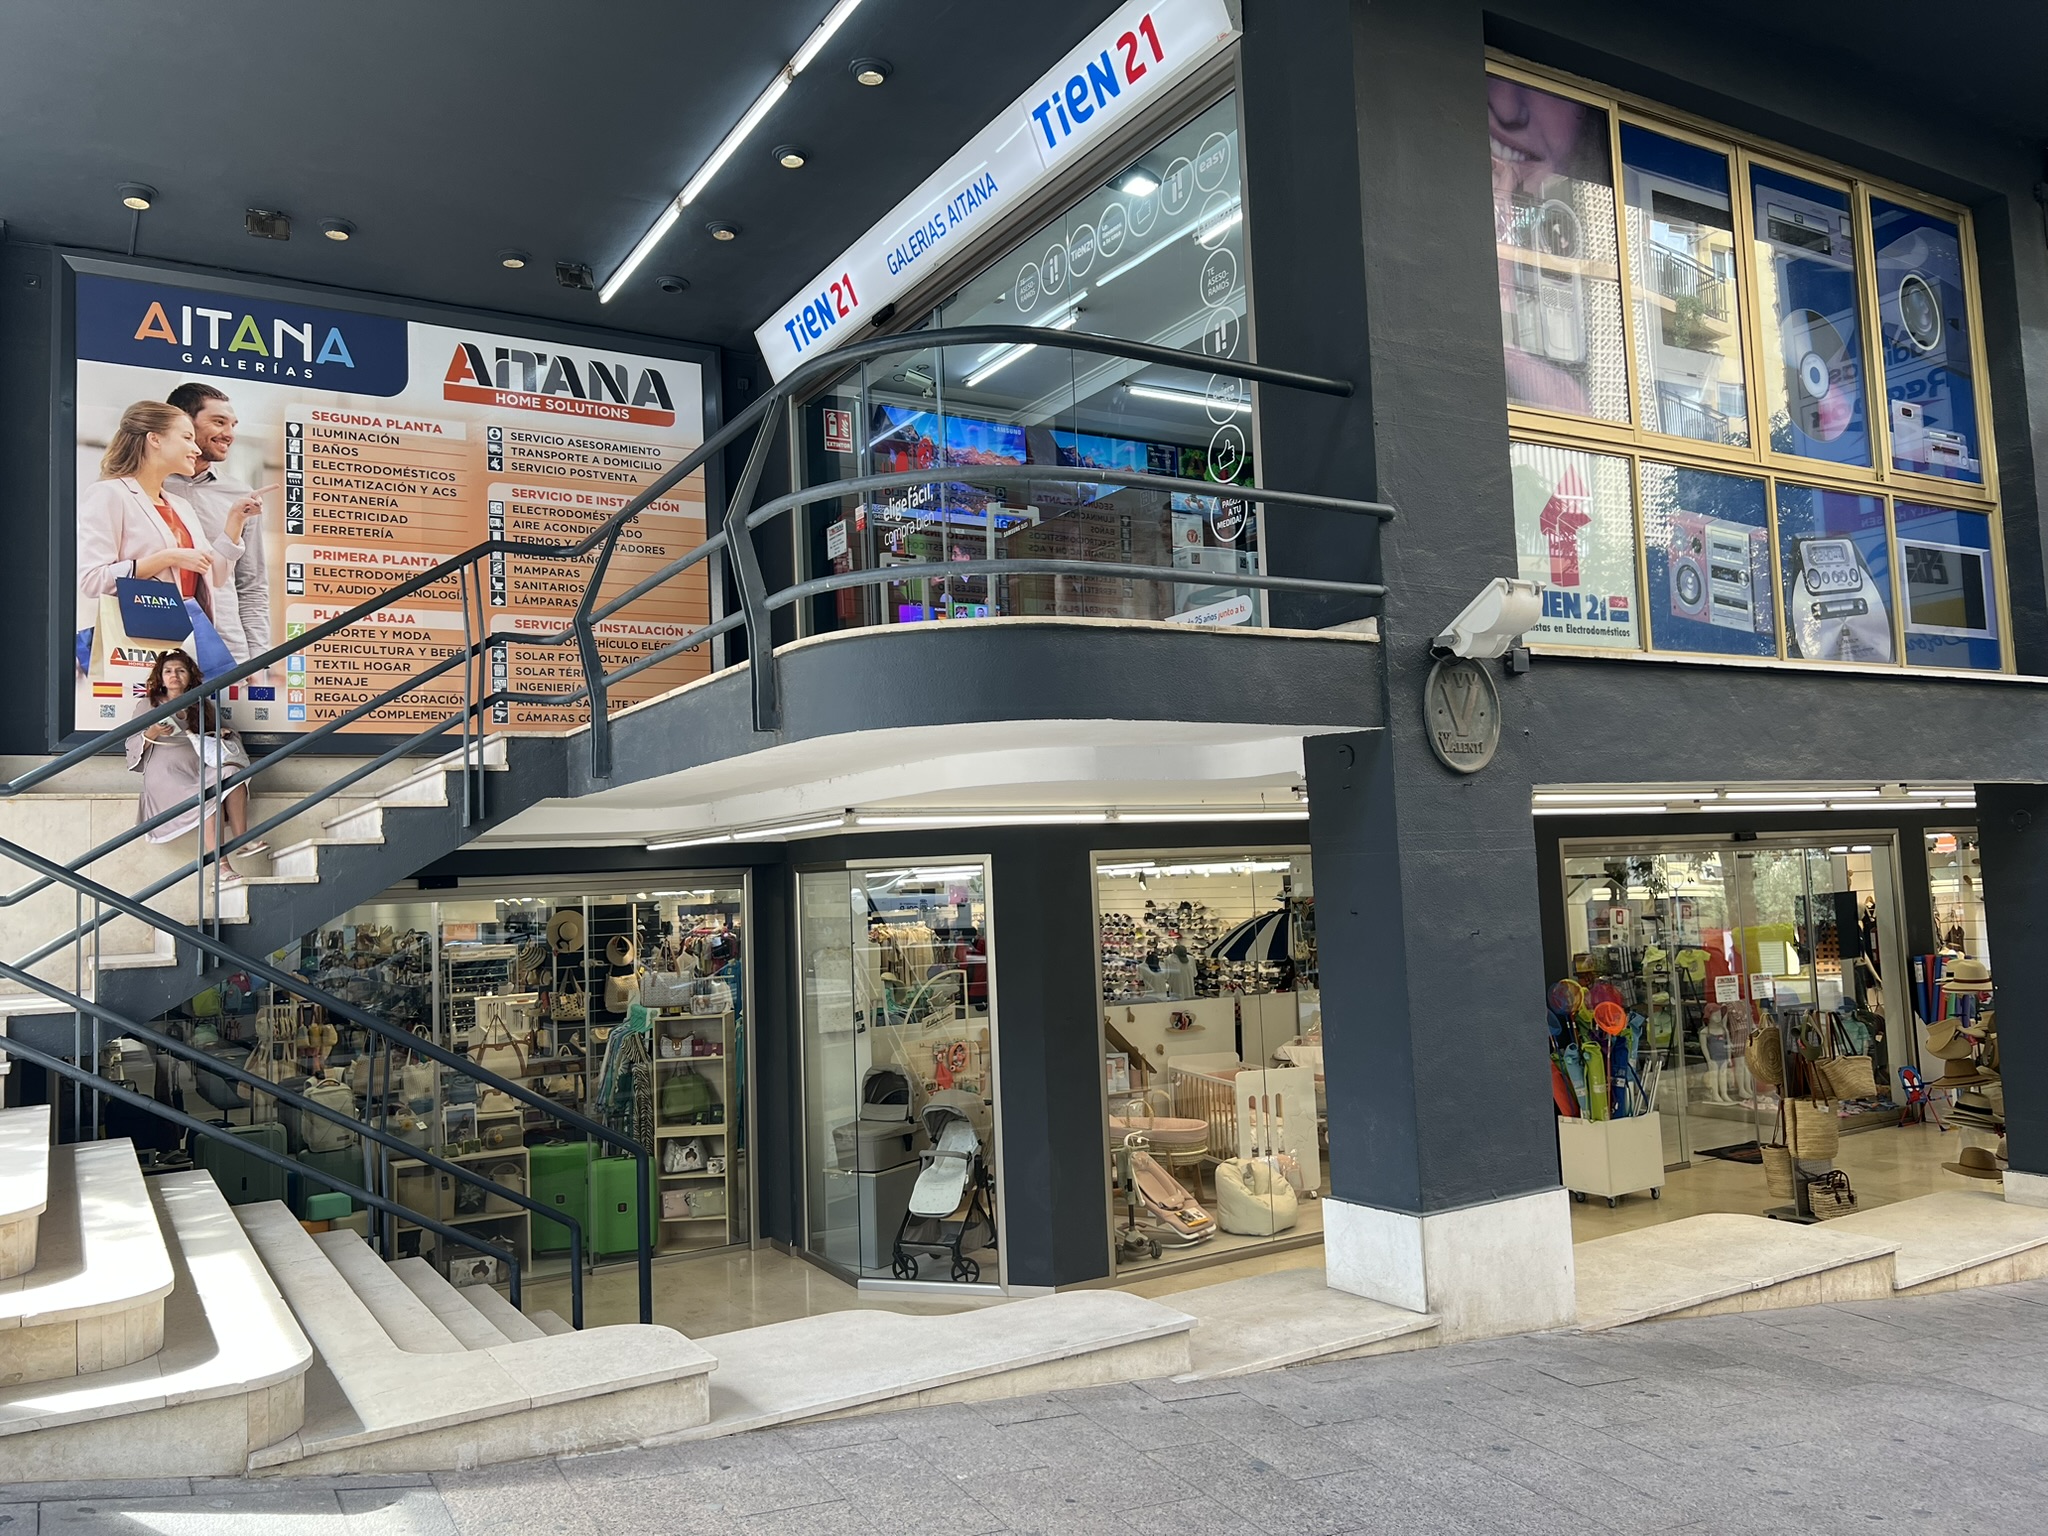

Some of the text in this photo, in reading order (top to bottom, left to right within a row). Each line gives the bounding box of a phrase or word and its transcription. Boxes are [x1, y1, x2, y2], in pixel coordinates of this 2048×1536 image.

[1200, 148, 1226, 173] easy
[886, 172, 999, 277] GALERIAS AITANA
[1207, 267, 1215, 277] TE
[1207, 270, 1230, 287] ASESO-
[1208, 279, 1230, 297] RAMOS
[134, 301, 355, 369] AITANA
[182, 352, 314, 379] GALERÍAS
[444, 341, 675, 411] AITANA
[496, 393, 630, 420] HOME SOLUTIONS
[312, 411, 443, 434] SEGUNDA PLANTA
[312, 428, 400, 445] ILUMINACIÓN
[510, 431, 661, 457] SERVICIO ASESORAMIENTO
[312, 443, 359, 457] BAÑOS
[511, 447, 662, 471] TRANSPORTE A DOMICILIO
[312, 460, 456, 481] ELECTRODOMÉSTICOS
[511, 462, 637, 483] SERVICIO POSTVENTA
[312, 476, 457, 497] CLIMATIZACIÓN Y ACS
[312, 492, 398, 507] FONTANERÍA
[512, 488, 680, 513] SERVICIO DE INSTACIÓN
[313, 509, 408, 524] ELECTRICIDAD
[512, 505, 639, 524] ELECTRODOMÉSTOS
[1217, 514, 1242, 530] MEDIDA!
[313, 524, 393, 538] FERRETERÍA
[512, 520, 642, 539] AIRE ACONDICADO
[884, 521, 915, 546] compra
[916, 511, 935, 533] bien
[513, 535, 560, 547] TERMOS
[564, 539, 571, 547] Y
[313, 550, 439, 567] PRIMERA PLANTA
[314, 567, 457, 585] ELECTRODOMÉSCOS
[514, 566, 580, 578] MAMPARAS
[314, 583, 333, 594] TV,
[336, 584, 376, 595] AUDIO
[514, 580, 585, 593] SANITARIOS
[134, 594, 178, 607] AITANA
[514, 595, 579, 608] LÁMPARAS
[1541, 590, 1607, 621] IEN 21
[313, 610, 415, 624] PLAA BAJA
[1203, 612, 1217, 623] años
[1218, 608, 1234, 621] junto
[327, 629, 431, 641] PORTE Y MODA
[515, 619, 574, 631] SERVICIO
[600, 624, 684, 637] INSTALACIÓN
[1554, 625, 1563, 633] en
[1566, 624, 1631, 637] Electrodomésticos
[314, 644, 414, 656] PUERICULTURA
[419, 648, 427, 656] Y
[592, 638, 639, 650] EHÍCULO
[641, 641, 700, 653] ELÉCCO
[110, 647, 158, 662] AITA
[515, 652, 554, 662] SOLAR
[314, 660, 411, 672] TEXTIL HOGAR
[515, 667, 555, 677] SOLAR
[314, 677, 369, 687] MENAJE
[516, 681, 582, 692] INGENIERÍA
[314, 692, 368, 703] REGALO
[392, 693, 465, 705] ECORACIÓN
[576, 700, 628, 709] SALITE
[315, 709, 460, 720] VIAJ COMPLEMENT
[517, 711, 575, 723] CÁMARAS
